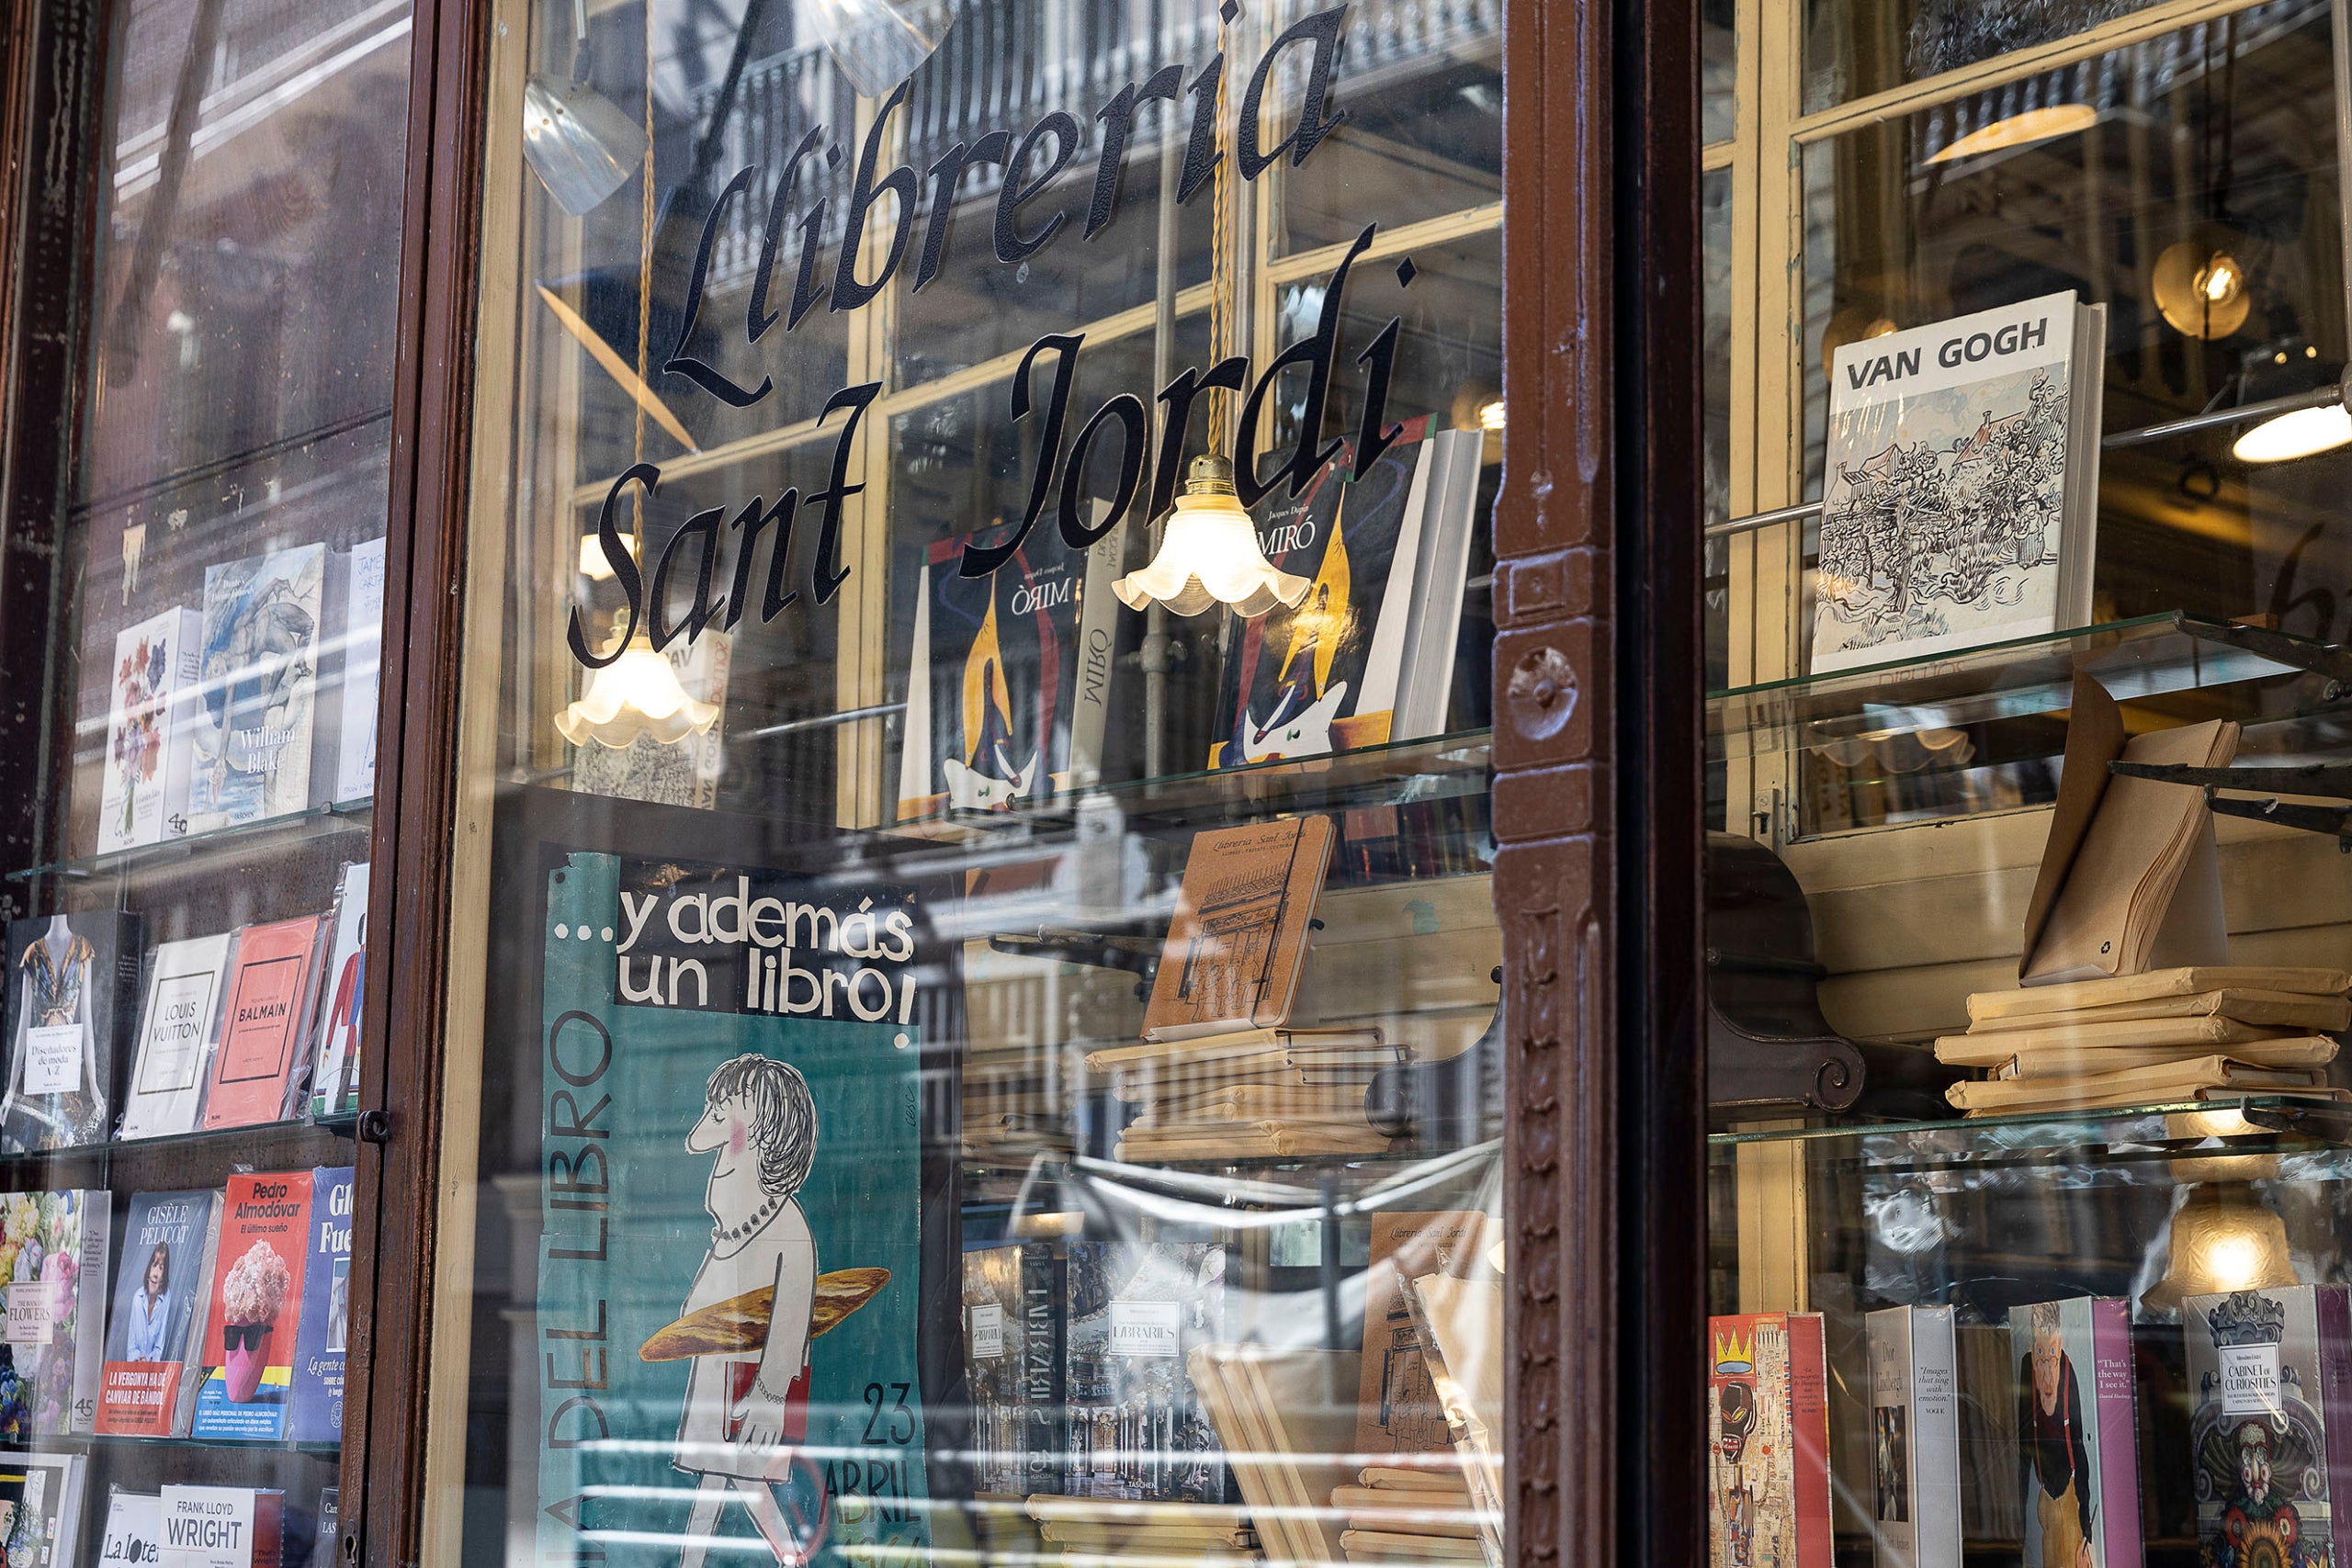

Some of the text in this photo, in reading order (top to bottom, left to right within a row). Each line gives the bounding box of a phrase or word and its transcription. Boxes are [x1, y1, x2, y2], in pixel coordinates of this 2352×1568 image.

[662, 0, 1349, 408] Llibreria
[1847, 317, 2048, 390] VAN GOGH
[566, 221, 1418, 670] Sant Jordi
[1267, 510, 1289, 522] Jacques
[1258, 514, 1316, 556] MIRÓ
[241, 726, 295, 750] William
[247, 750, 285, 774] Blake
[168, 813, 188, 834] 40
[1257, 832, 1280, 845] Sant
[667, 875, 917, 962] además
[618, 947, 917, 1050] un libro!
[164, 1001, 197, 1021] LOUIS
[238, 1002, 287, 1022] BALMAIN
[153, 1021, 201, 1042] VUITTON
[548, 1010, 613, 1262] LIBRO
[252, 1182, 288, 1200] Pedro
[147, 1202, 189, 1224] GISÈLE
[234, 1200, 300, 1220] Almodóvar
[140, 1225, 189, 1246] PELICOT
[241, 1224, 246, 1234] El
[268, 1224, 288, 1234] sueño
[9, 1308, 51, 1321] FLOWERS
[1114, 1325, 1175, 1338] LIBRARIES
[307, 1356, 318, 1375] La
[317, 1359, 339, 1377] gente
[546, 1298, 609, 1450] DEL
[2098, 1369, 2127, 1380] the way
[2228, 1364, 2263, 1378] CABINET
[109, 1371, 118, 1385] LA
[118, 1371, 148, 1386] VERGONYA
[149, 1372, 157, 1386] HA
[1918, 1376, 1949, 1386] that sing
[1926, 1384, 1942, 1393] with
[2099, 1380, 2104, 1388] I
[2224, 1377, 2277, 1391] CURIOSITIES
[106, 1389, 132, 1404] CANVIAR
[131, 1390, 141, 1404] DE
[74, 1397, 93, 1417] 45
[860, 1382, 916, 1445] 23
[818, 1459, 922, 1525] ABRIL
[1127, 1481, 1156, 1489] TASCHEN
[176, 1501, 233, 1516] FRANK LLOYD
[167, 1517, 243, 1550] WRIGHT
[322, 1521, 336, 1534] LAS
[103, 1533, 121, 1559] La
